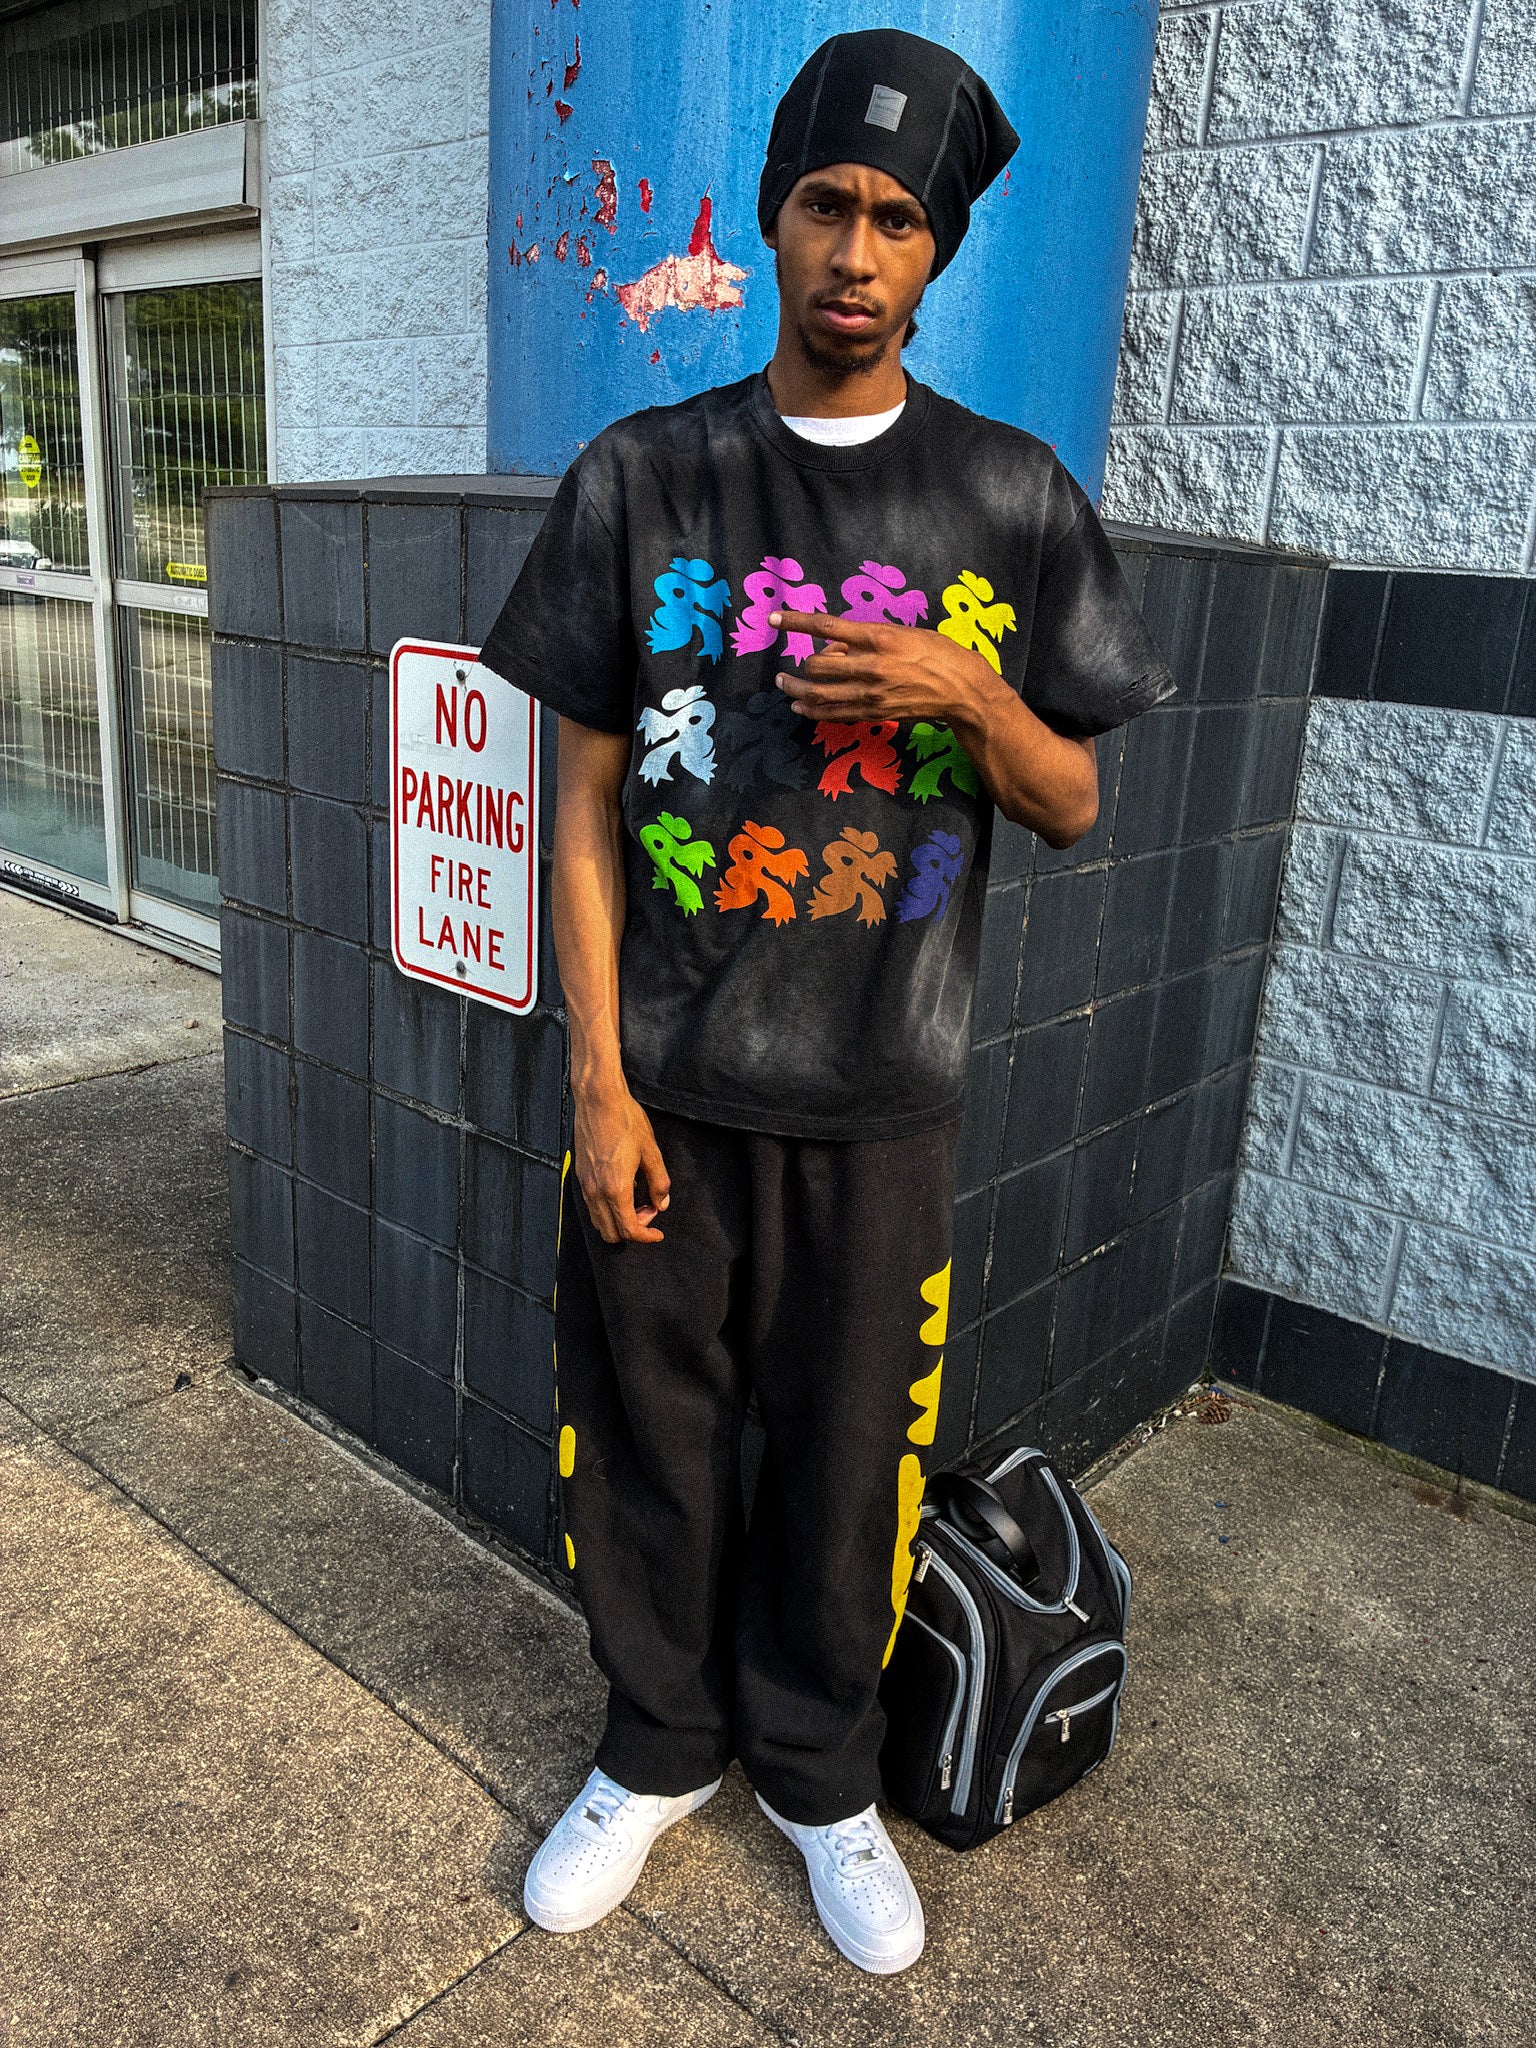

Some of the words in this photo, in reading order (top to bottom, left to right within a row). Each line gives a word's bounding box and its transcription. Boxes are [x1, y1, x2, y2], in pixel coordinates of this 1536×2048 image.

[435, 683, 487, 753] NO
[402, 766, 524, 853] PARKING
[431, 854, 492, 909] FIRE
[418, 906, 505, 971] LANE
